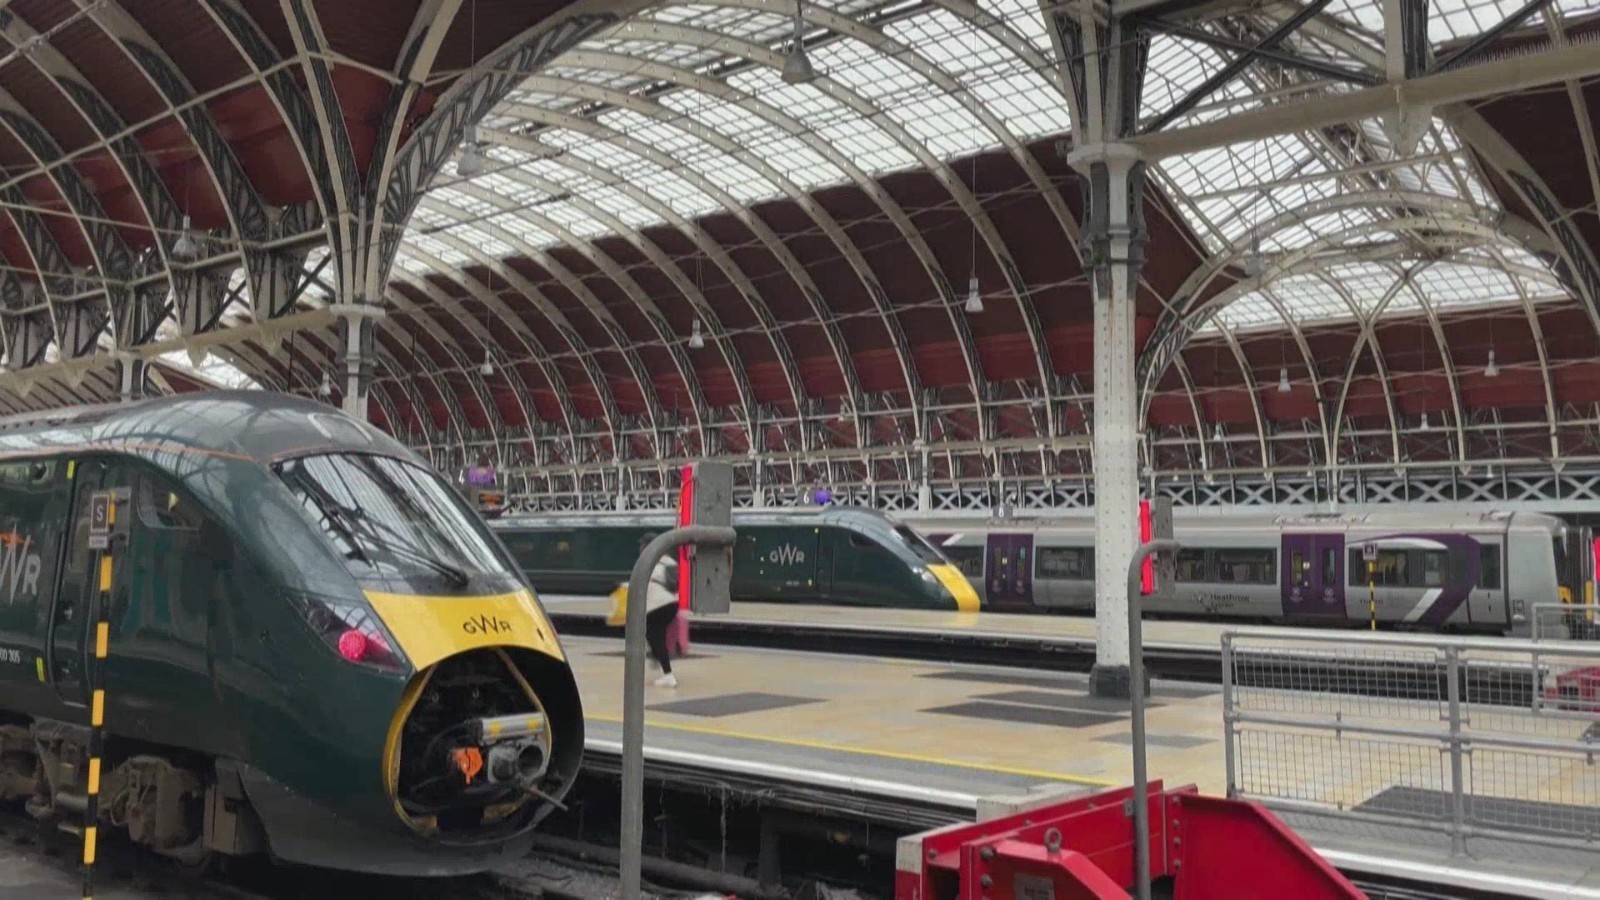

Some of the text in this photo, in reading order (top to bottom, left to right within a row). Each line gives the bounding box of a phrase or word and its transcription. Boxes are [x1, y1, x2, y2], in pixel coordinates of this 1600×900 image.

[803, 491, 810, 504] 6
[96, 504, 104, 522] S
[770, 542, 804, 566] GWR
[463, 613, 512, 635] GWR
